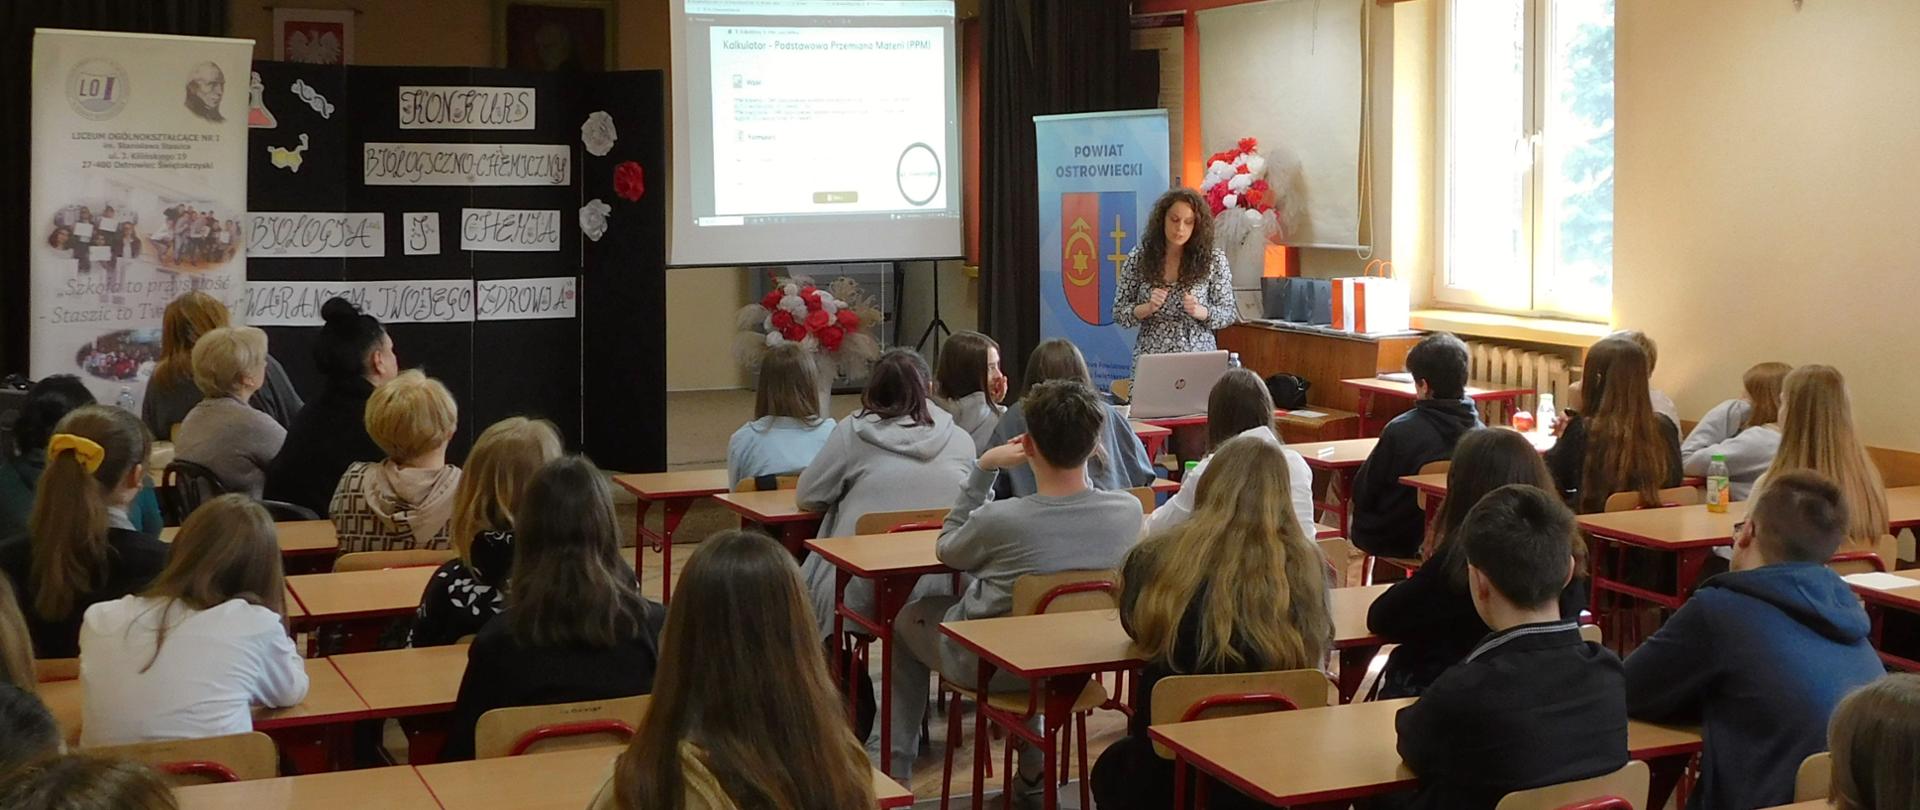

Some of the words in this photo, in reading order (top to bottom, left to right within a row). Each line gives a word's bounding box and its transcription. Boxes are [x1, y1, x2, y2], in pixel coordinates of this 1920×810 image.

[723, 40, 767, 50] Kalkulator
[774, 40, 829, 51] Podstawowa
[906, 39, 932, 50] (PPM)
[400, 89, 529, 124] KONKURS
[72, 132, 106, 140] LICEUM
[1074, 144, 1124, 158] POWIAT
[1055, 163, 1143, 178] OSTROWIECKI
[463, 210, 557, 245] CHEMIA
[126, 279, 143, 294] to
[50, 304, 112, 325] Staszic
[116, 307, 134, 322] to
